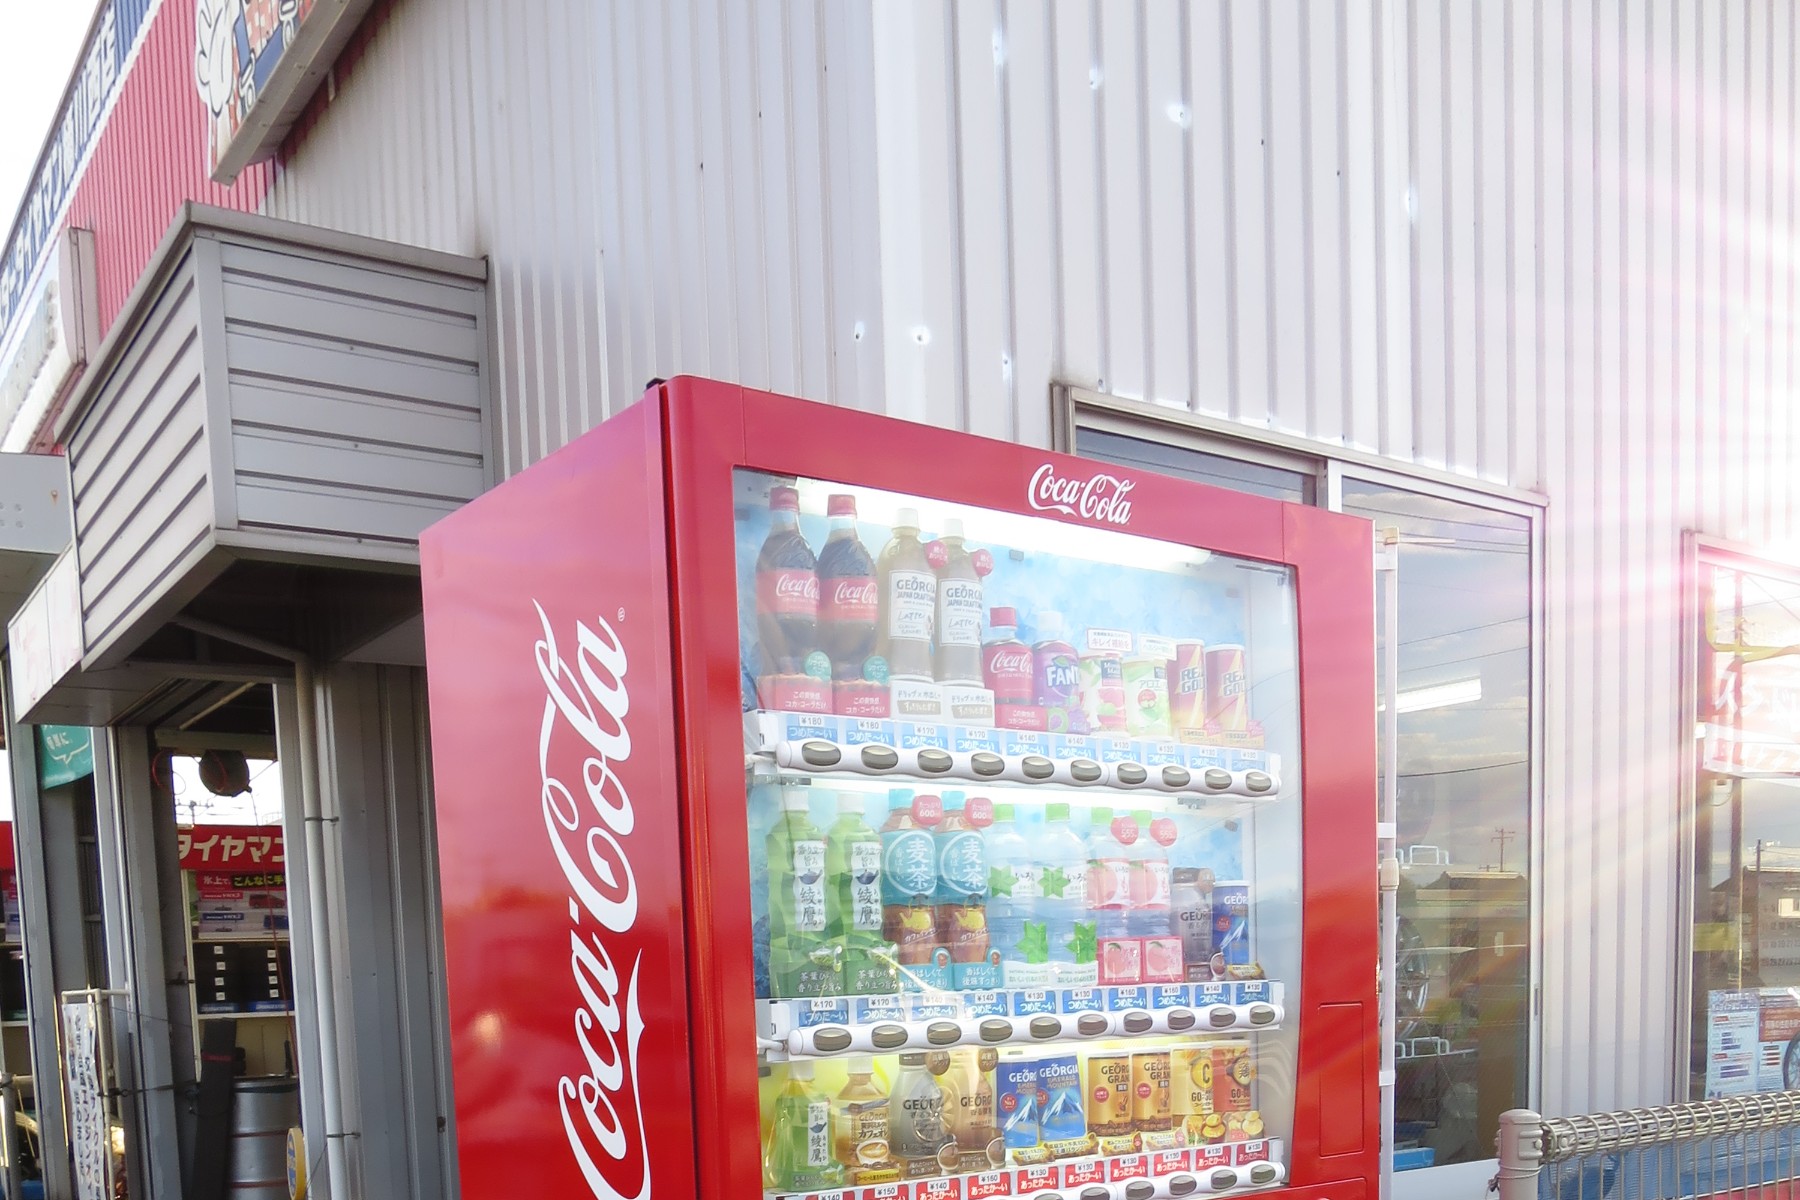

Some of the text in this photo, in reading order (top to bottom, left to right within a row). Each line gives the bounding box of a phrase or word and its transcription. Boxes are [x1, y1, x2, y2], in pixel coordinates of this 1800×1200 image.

[1028, 463, 1136, 524] Coca-Cola
[800, 717, 823, 726] ¥180
[859, 720, 881, 730] ¥180
[906, 838, 933, 890] 麦茶
[962, 838, 984, 890] 麦茶
[799, 888, 818, 928] 綾鷹
[857, 888, 875, 928] 綾鷹
[810, 1135, 823, 1162] 綾鷹
[1029, 1168, 1048, 1178] ¥130
[1068, 1172, 1102, 1184] あったか〜い
[1113, 1166, 1146, 1178] あったか〜い
[929, 1181, 948, 1191] ¥140
[971, 1184, 1008, 1196] あったか〜い
[1021, 1178, 1057, 1190] あったか〜い
[876, 1187, 896, 1196] ¥150
